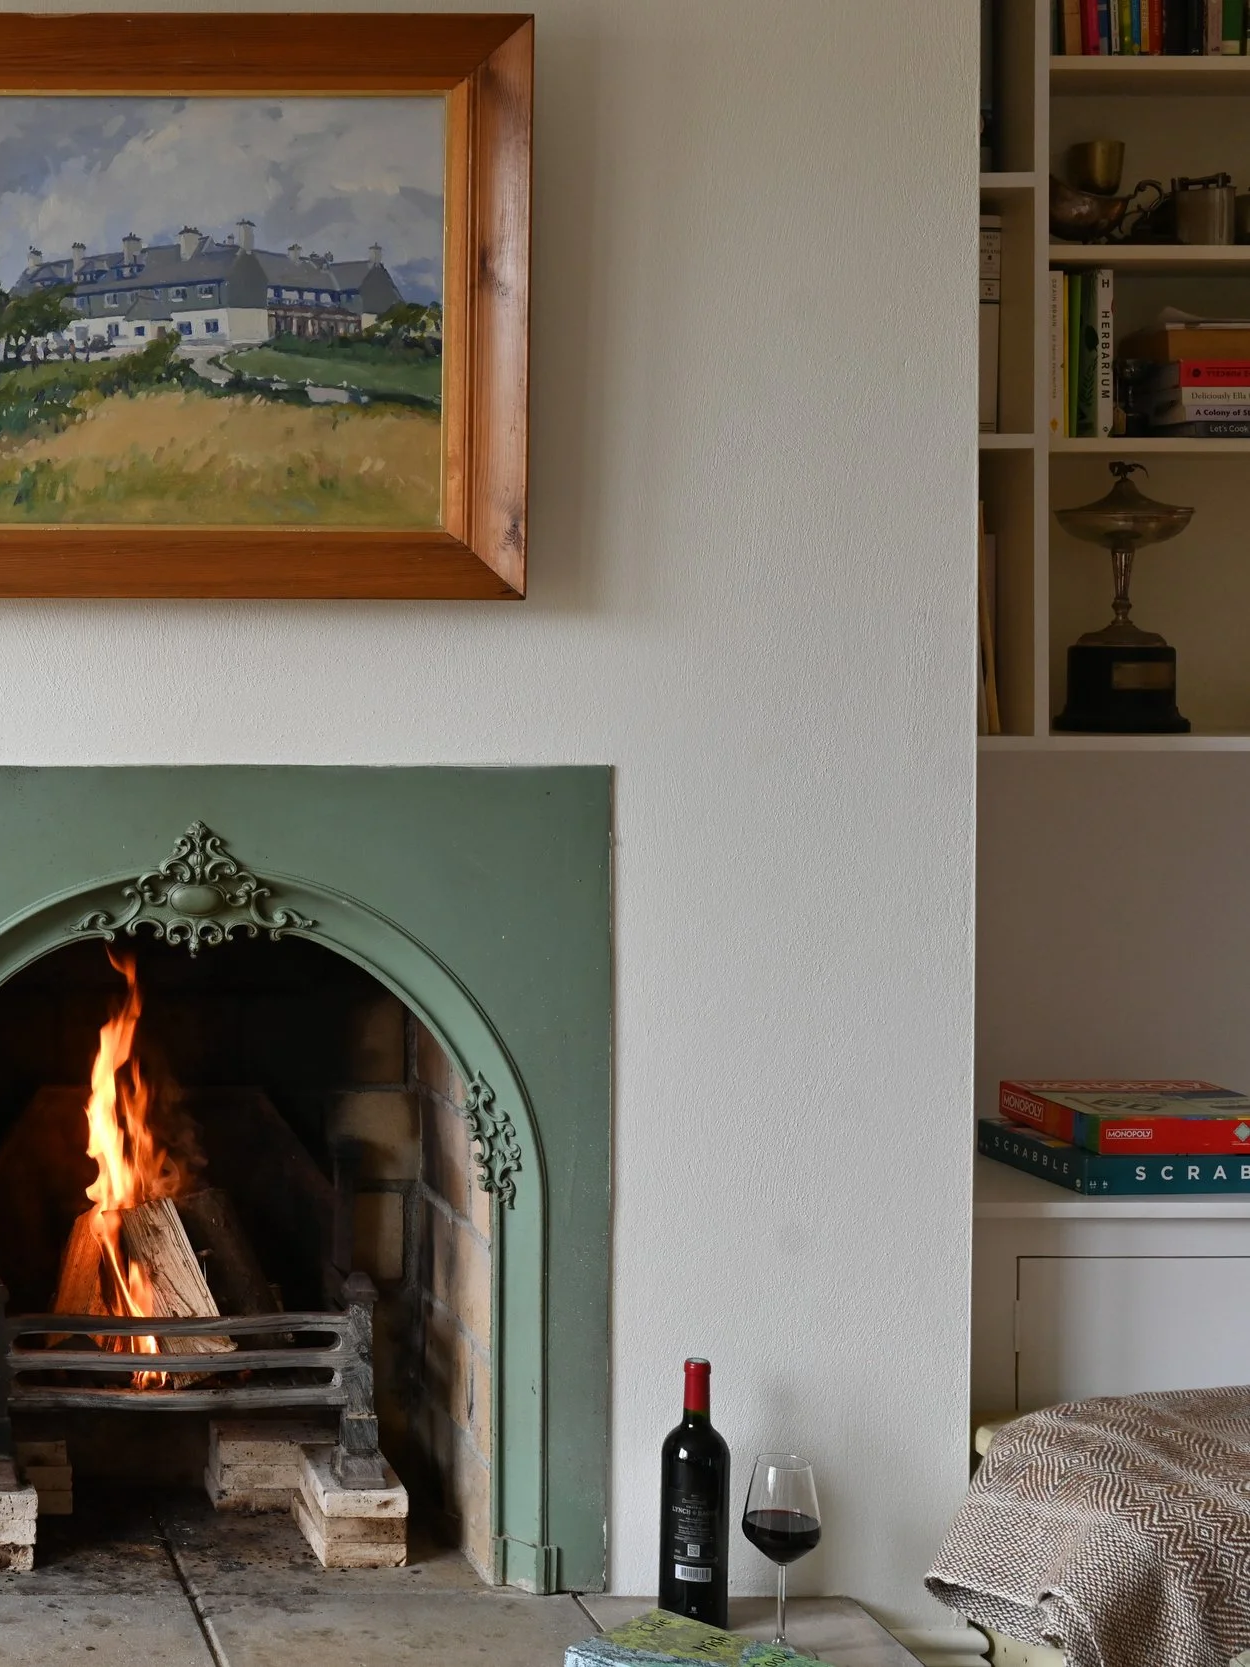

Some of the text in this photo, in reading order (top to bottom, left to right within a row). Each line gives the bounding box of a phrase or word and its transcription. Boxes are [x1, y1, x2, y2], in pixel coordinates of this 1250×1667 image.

[1101, 310, 1110, 399] HERBARIUM
[1191, 391, 1247, 402] Deliciously Ella
[1204, 409, 1231, 418] Colony
[1021, 1081, 1211, 1090] MONOPOLY
[1002, 1095, 1043, 1119] MONOPOLY
[1108, 1130, 1151, 1138] MONOPOLY
[994, 1136, 1070, 1174] SCRABBLE
[692, 1634, 732, 1653] Irish
